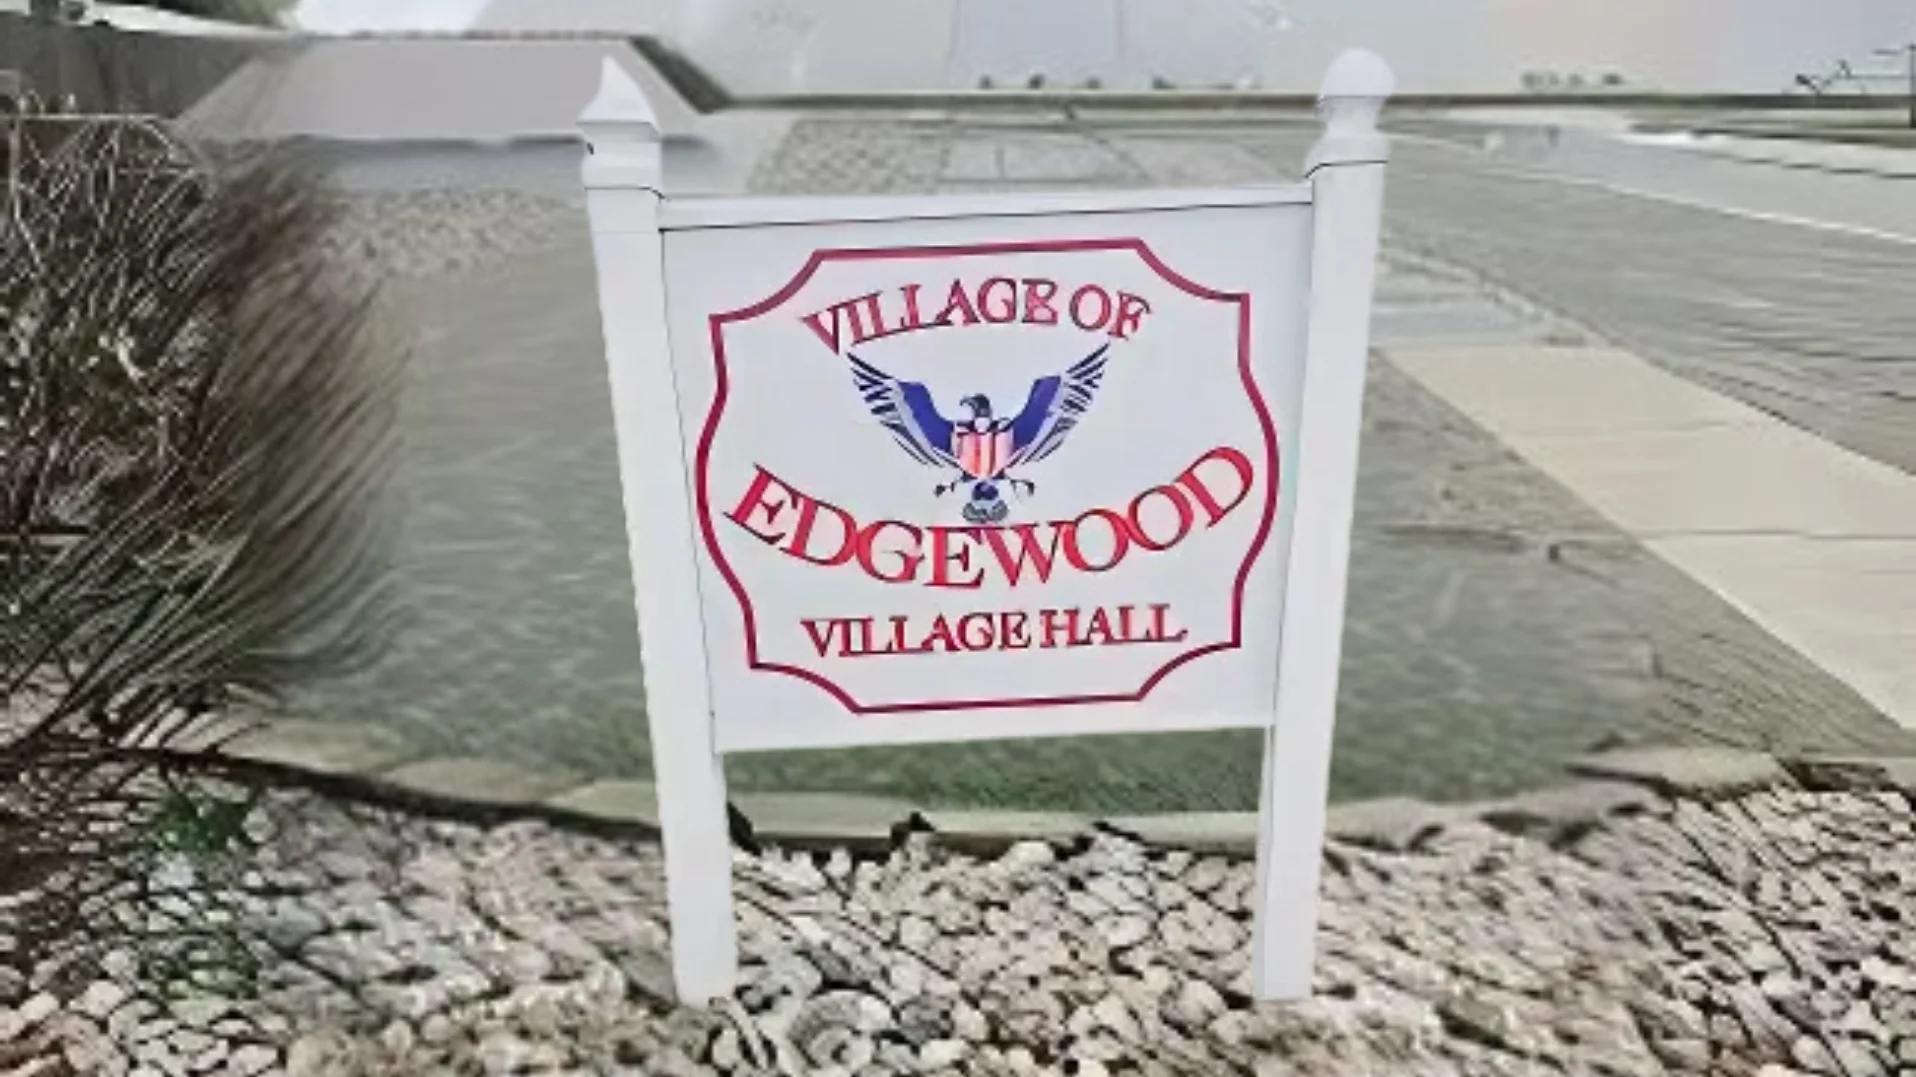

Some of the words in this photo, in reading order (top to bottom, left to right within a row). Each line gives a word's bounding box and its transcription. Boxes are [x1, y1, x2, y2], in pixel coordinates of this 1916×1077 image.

[801, 278, 1059, 355] VILLAGE
[1069, 283, 1153, 341] OF
[724, 446, 1255, 589] EDGEWOOD
[802, 611, 1032, 658] VILLAGE
[1039, 604, 1189, 647] HALL
